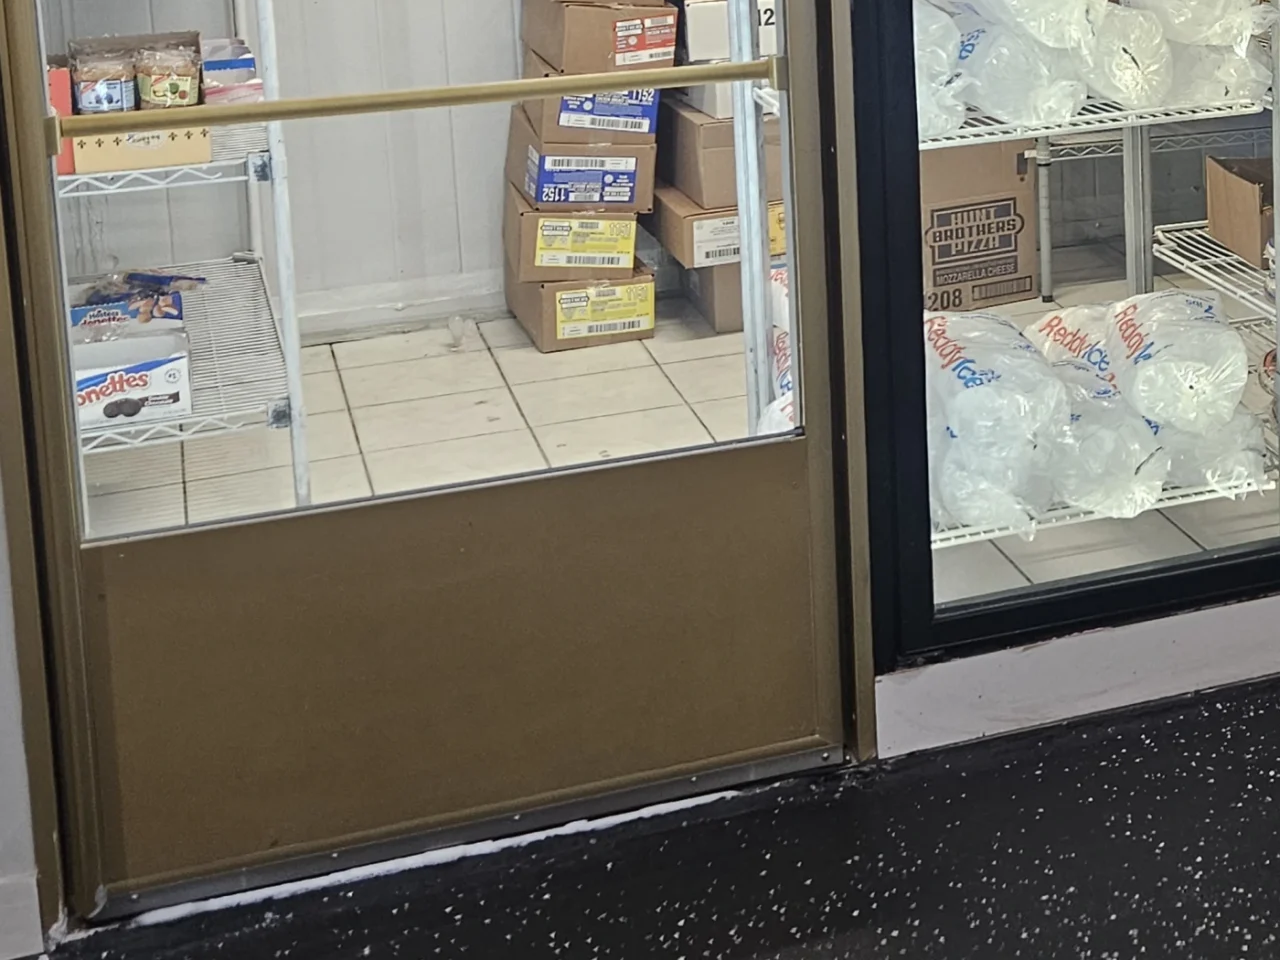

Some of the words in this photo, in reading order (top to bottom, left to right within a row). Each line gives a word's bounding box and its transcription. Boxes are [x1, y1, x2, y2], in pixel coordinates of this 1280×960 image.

[632, 88, 656, 101] 1152
[951, 208, 997, 226] HUNT
[932, 219, 1016, 243] BROTHERS
[951, 236, 1000, 255] PIZZA
[937, 269, 986, 284] MOZZARELLA
[987, 263, 1016, 276] CHEESE
[928, 288, 963, 312] 208
[76, 372, 149, 407] onettes
